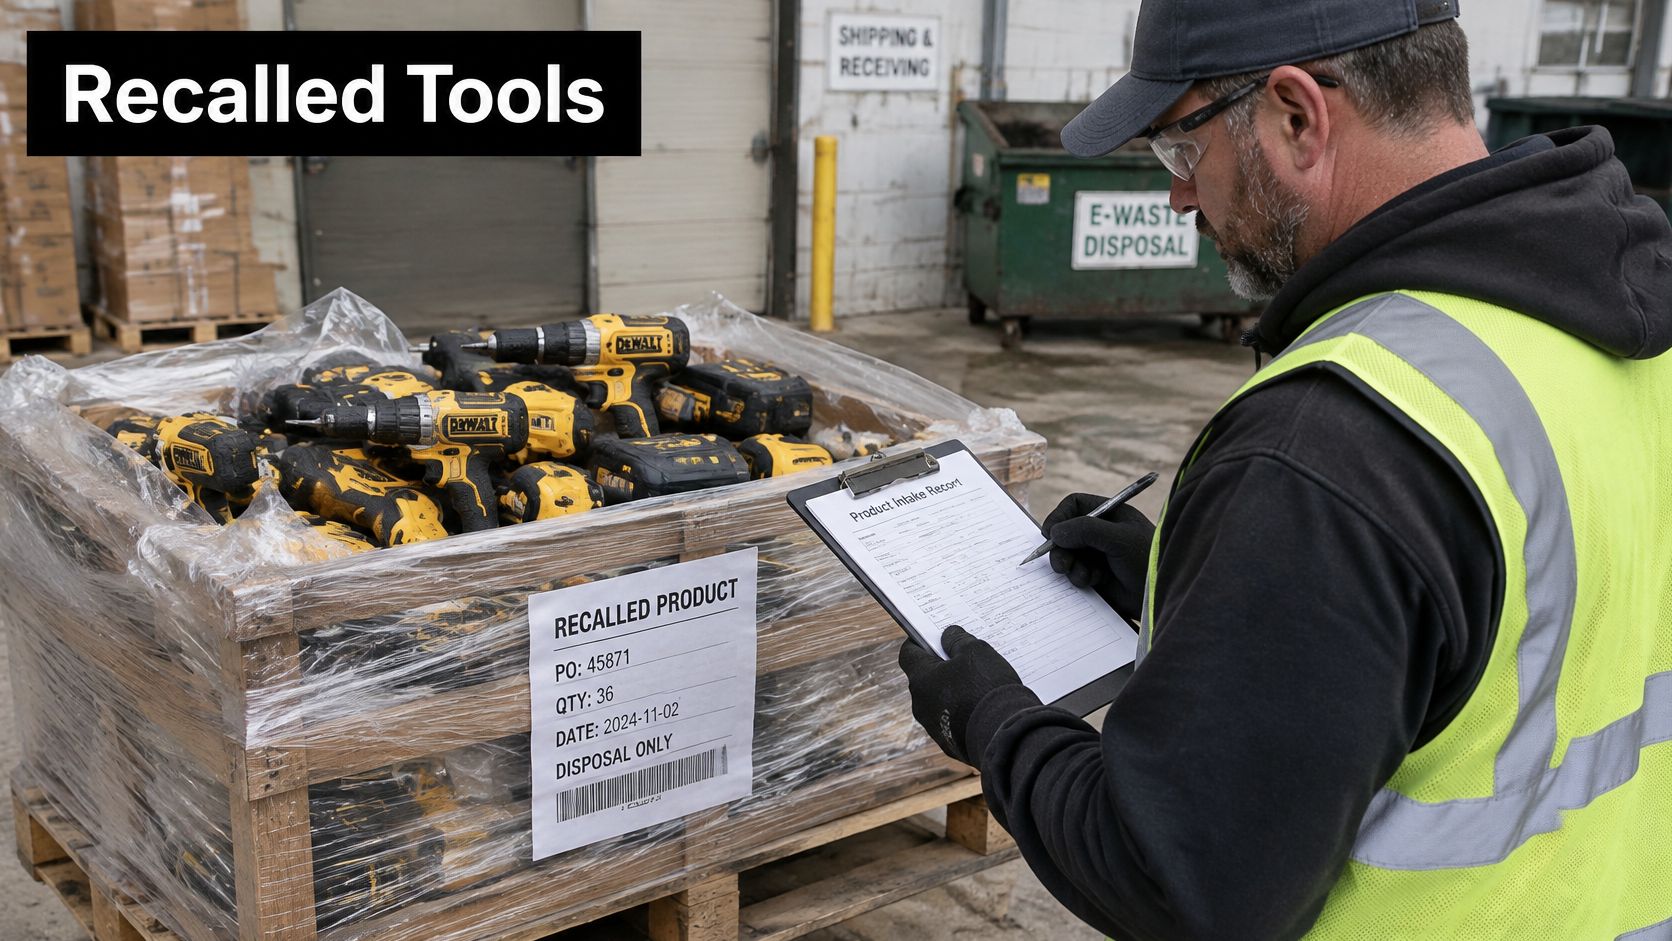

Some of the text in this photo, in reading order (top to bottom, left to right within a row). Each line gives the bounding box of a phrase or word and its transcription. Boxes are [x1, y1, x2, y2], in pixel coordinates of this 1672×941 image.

[839, 25, 933, 47] SHIPPING &
[840, 57, 930, 77] RECEIVING
[1090, 204, 1188, 226] E-WASTE
[1084, 235, 1188, 257] DISPOSAL
[849, 502, 894, 522] Product
[891, 492, 927, 508] Intake
[554, 577, 738, 639] RECALLED PRODUCT
[555, 648, 630, 683] PO: 45871
[556, 685, 614, 715] QTY: 36
[556, 701, 679, 748] DATE: 2024-11-02
[556, 733, 673, 780] DISPOSAL ONLY
